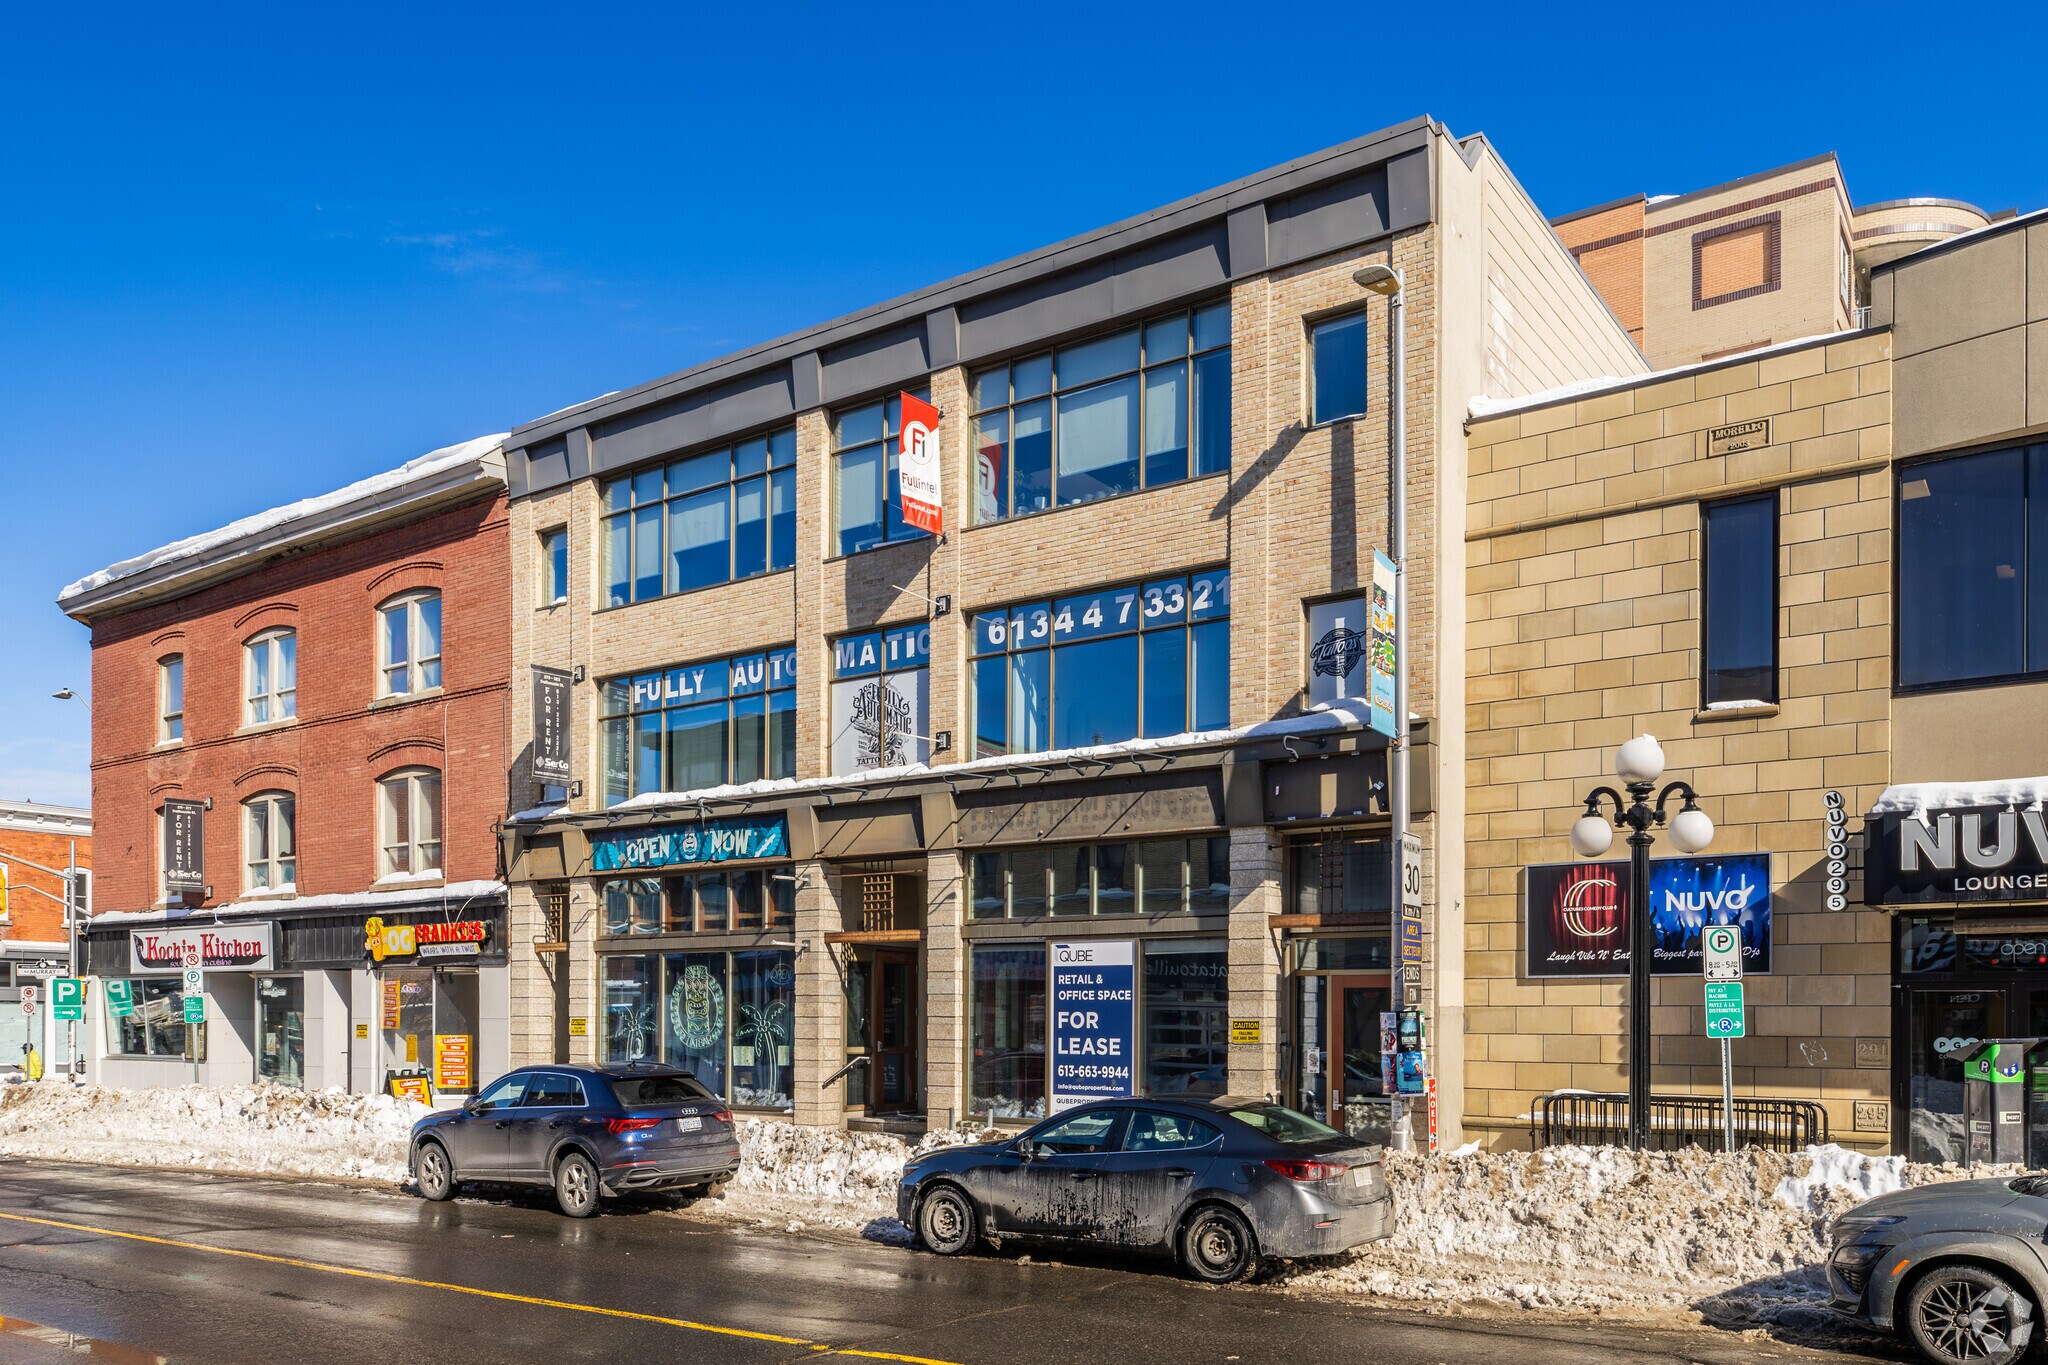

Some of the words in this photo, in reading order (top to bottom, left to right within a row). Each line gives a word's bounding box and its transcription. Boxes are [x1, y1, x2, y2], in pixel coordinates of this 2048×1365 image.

[1714, 421, 1766, 440] MORELLO
[901, 472, 939, 496] Fullintel
[835, 628, 930, 670] MATIC
[634, 668, 706, 704] FULLY
[544, 757, 569, 770] SerCo
[175, 814, 183, 837] FOR
[175, 839, 183, 869] RENT
[626, 833, 671, 863] OPEN
[710, 828, 751, 857] NOW
[177, 870, 202, 879] SerCo
[1404, 862, 1420, 897] 30
[1954, 874, 2048, 892] LOUNGE
[1665, 884, 1756, 912] NUVO
[415, 920, 483, 943] FRANKIES
[1406, 923, 1419, 937] AREA
[145, 937, 197, 961] Kochin
[200, 933, 262, 958] Kitchen
[387, 929, 411, 952] OG
[1717, 935, 1729, 948] P
[1059, 949, 1093, 962] QUBE
[1403, 944, 1421, 957] SECTEUR
[1546, 951, 1577, 964] Laugh
[1577, 950, 1596, 961] Vibe
[1612, 948, 1632, 960] Eat
[1653, 948, 1687, 961] Biggest
[1742, 946, 1760, 957] Djs
[2001, 943, 2046, 963] open
[1058, 974, 1093, 984] RETAIL
[1096, 974, 1103, 984] &
[1405, 966, 1420, 981] ENDS
[58, 983, 76, 1002] P
[1058, 990, 1095, 1000] OFFICE
[1097, 990, 1132, 1000] SPACE
[1409, 988, 1417, 1002] FIN
[1058, 1011, 1099, 1029] FOR
[1233, 1022, 1259, 1030] CAUTION
[1058, 1037, 1121, 1056] LEASE
[1058, 1064, 1129, 1079] 613-663-9944
[1857, 1106, 1886, 1120] 295
